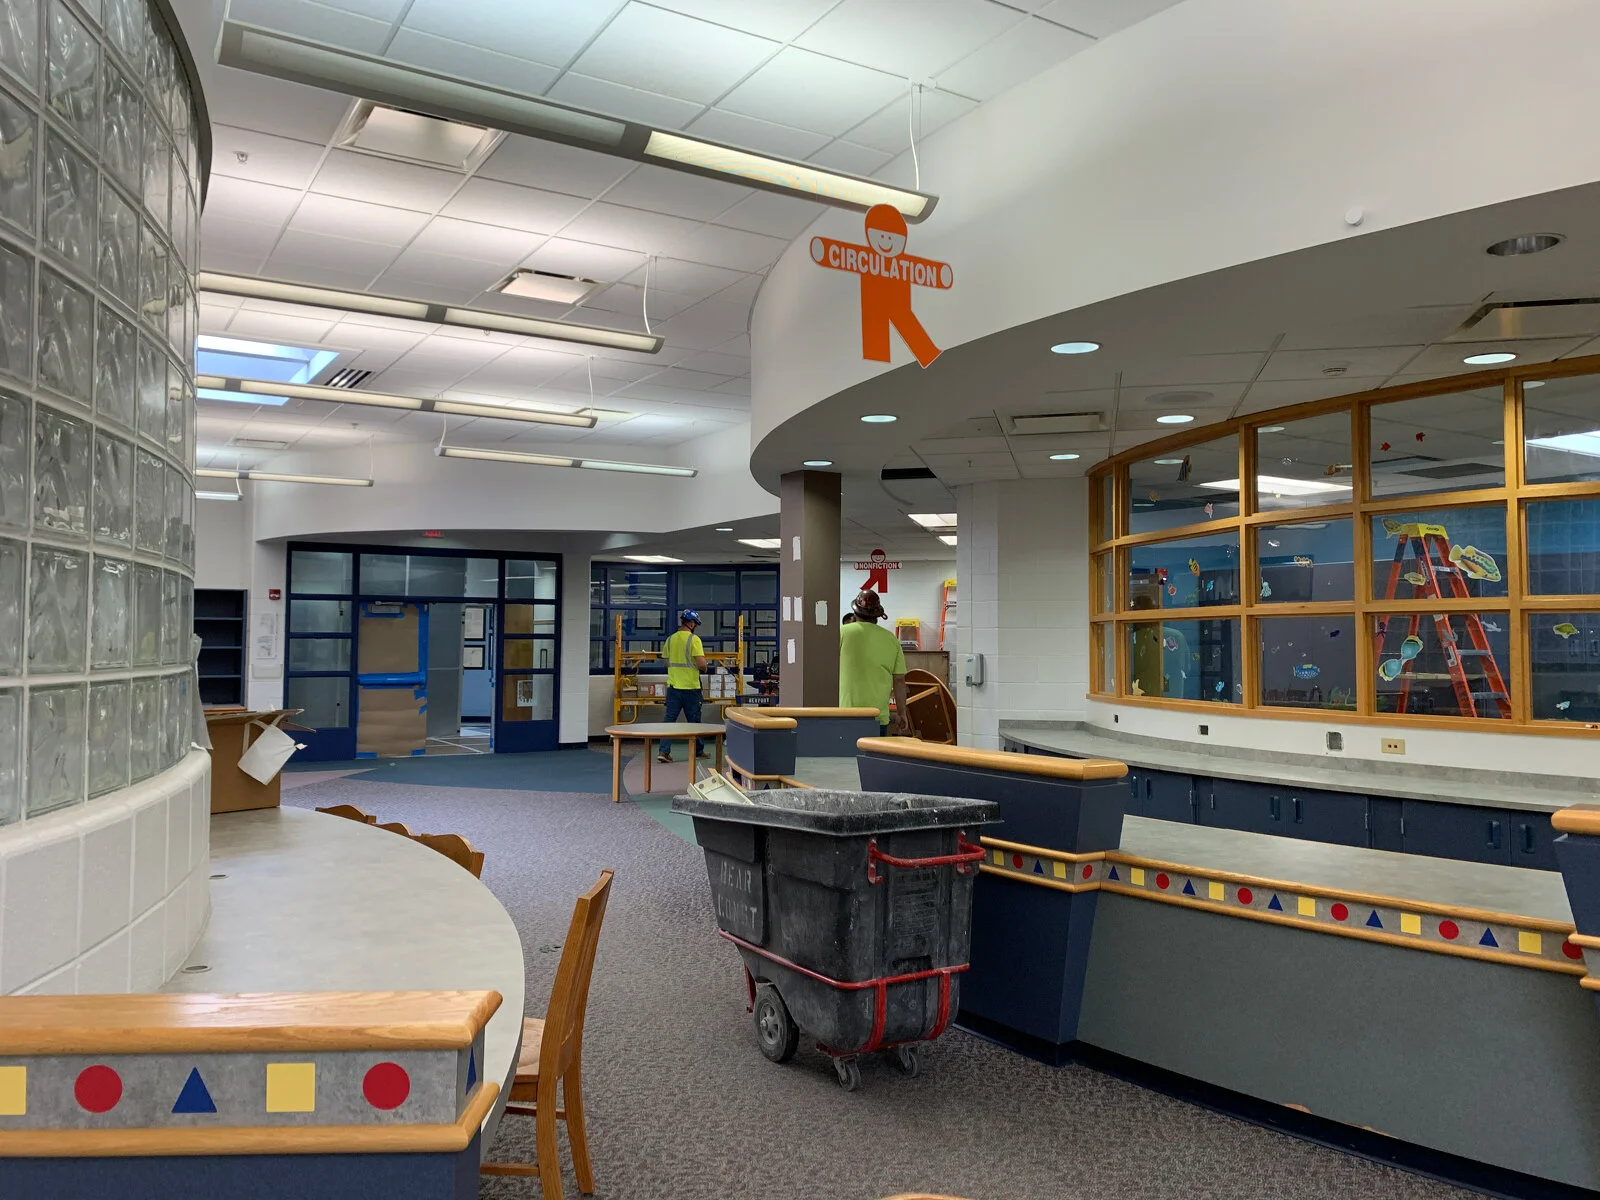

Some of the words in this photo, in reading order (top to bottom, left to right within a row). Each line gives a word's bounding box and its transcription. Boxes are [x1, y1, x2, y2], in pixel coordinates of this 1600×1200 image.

[828, 244, 937, 287] CIRCULATION
[859, 562, 898, 570] NONFICTION
[720, 860, 752, 894] BEAR
